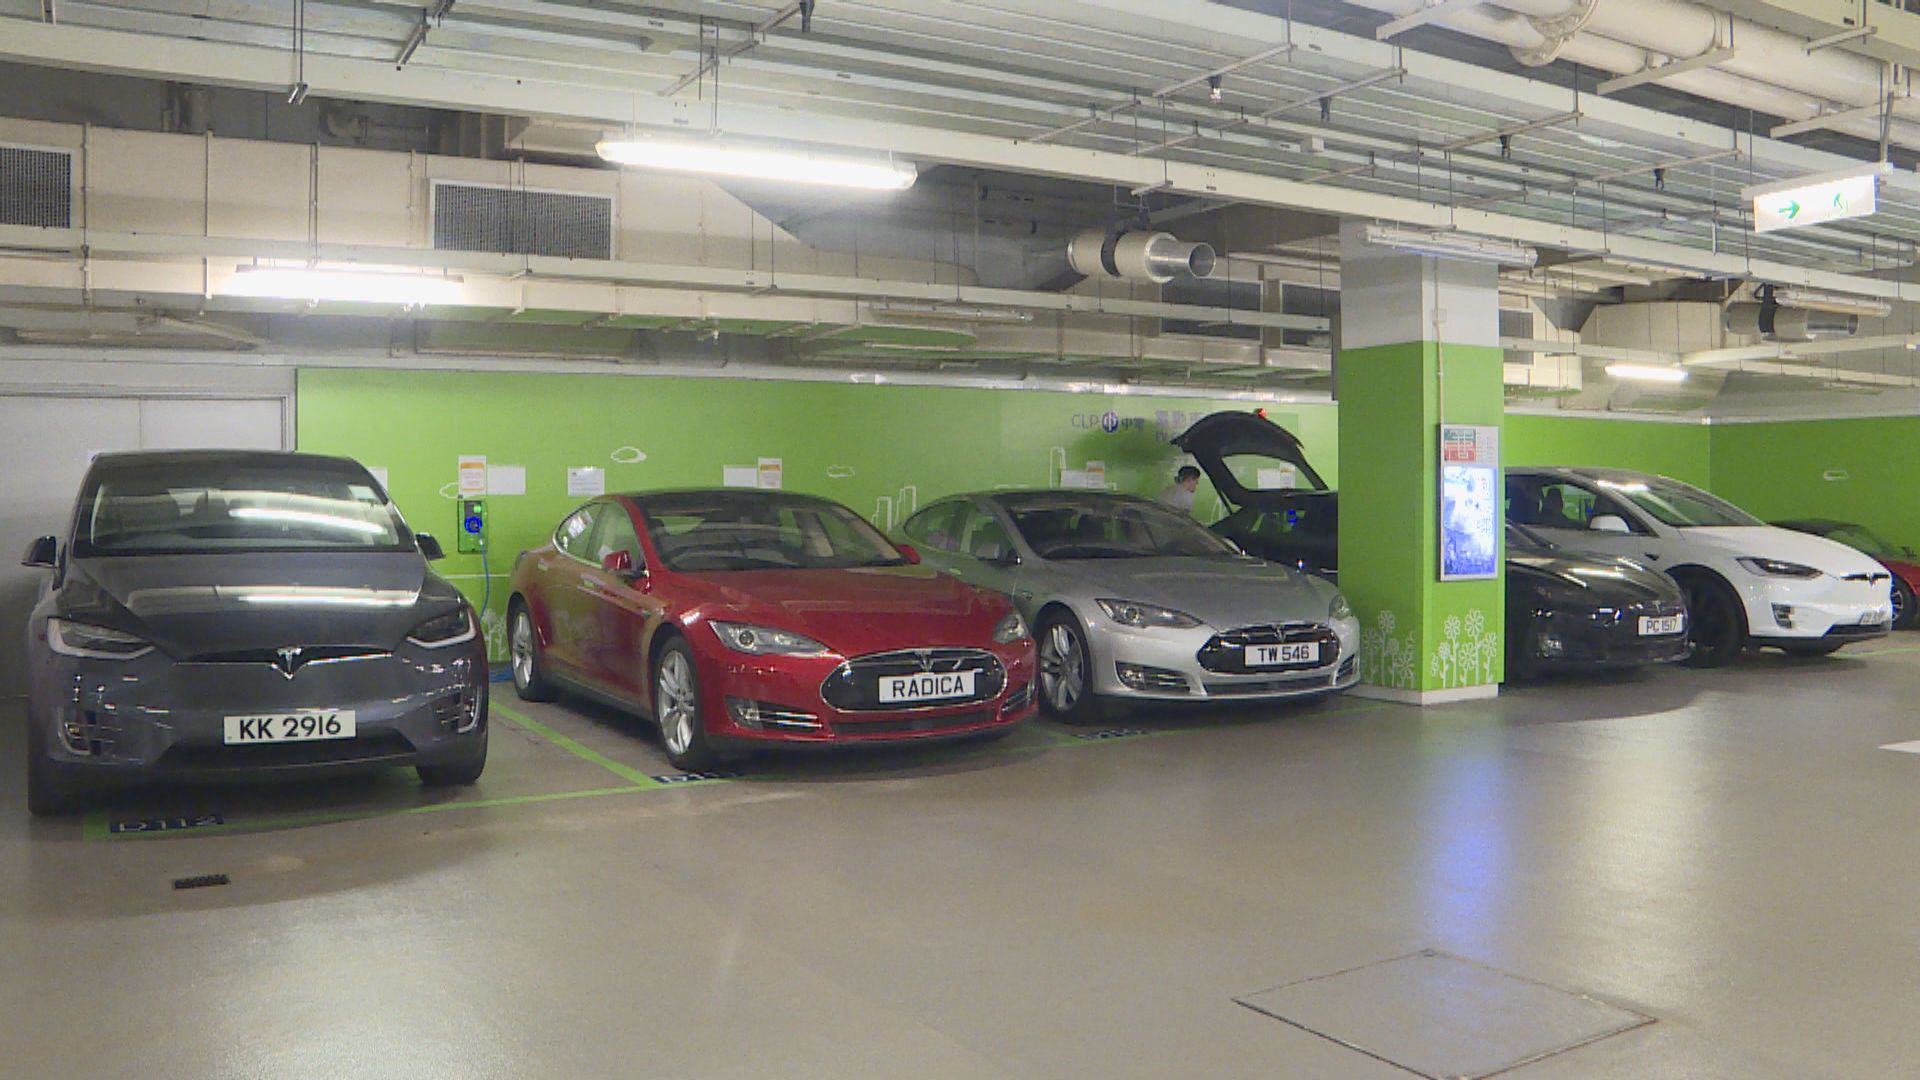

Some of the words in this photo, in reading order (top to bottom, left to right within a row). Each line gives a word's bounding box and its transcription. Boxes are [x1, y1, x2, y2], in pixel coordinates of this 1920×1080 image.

[1071, 414, 1099, 429] CLP
[1646, 619, 1660, 632] PC
[1257, 647, 1278, 662] TW
[1282, 645, 1310, 661] 546
[893, 676, 964, 698] RADICA
[240, 718, 274, 740] KK
[283, 715, 341, 737] 2916
